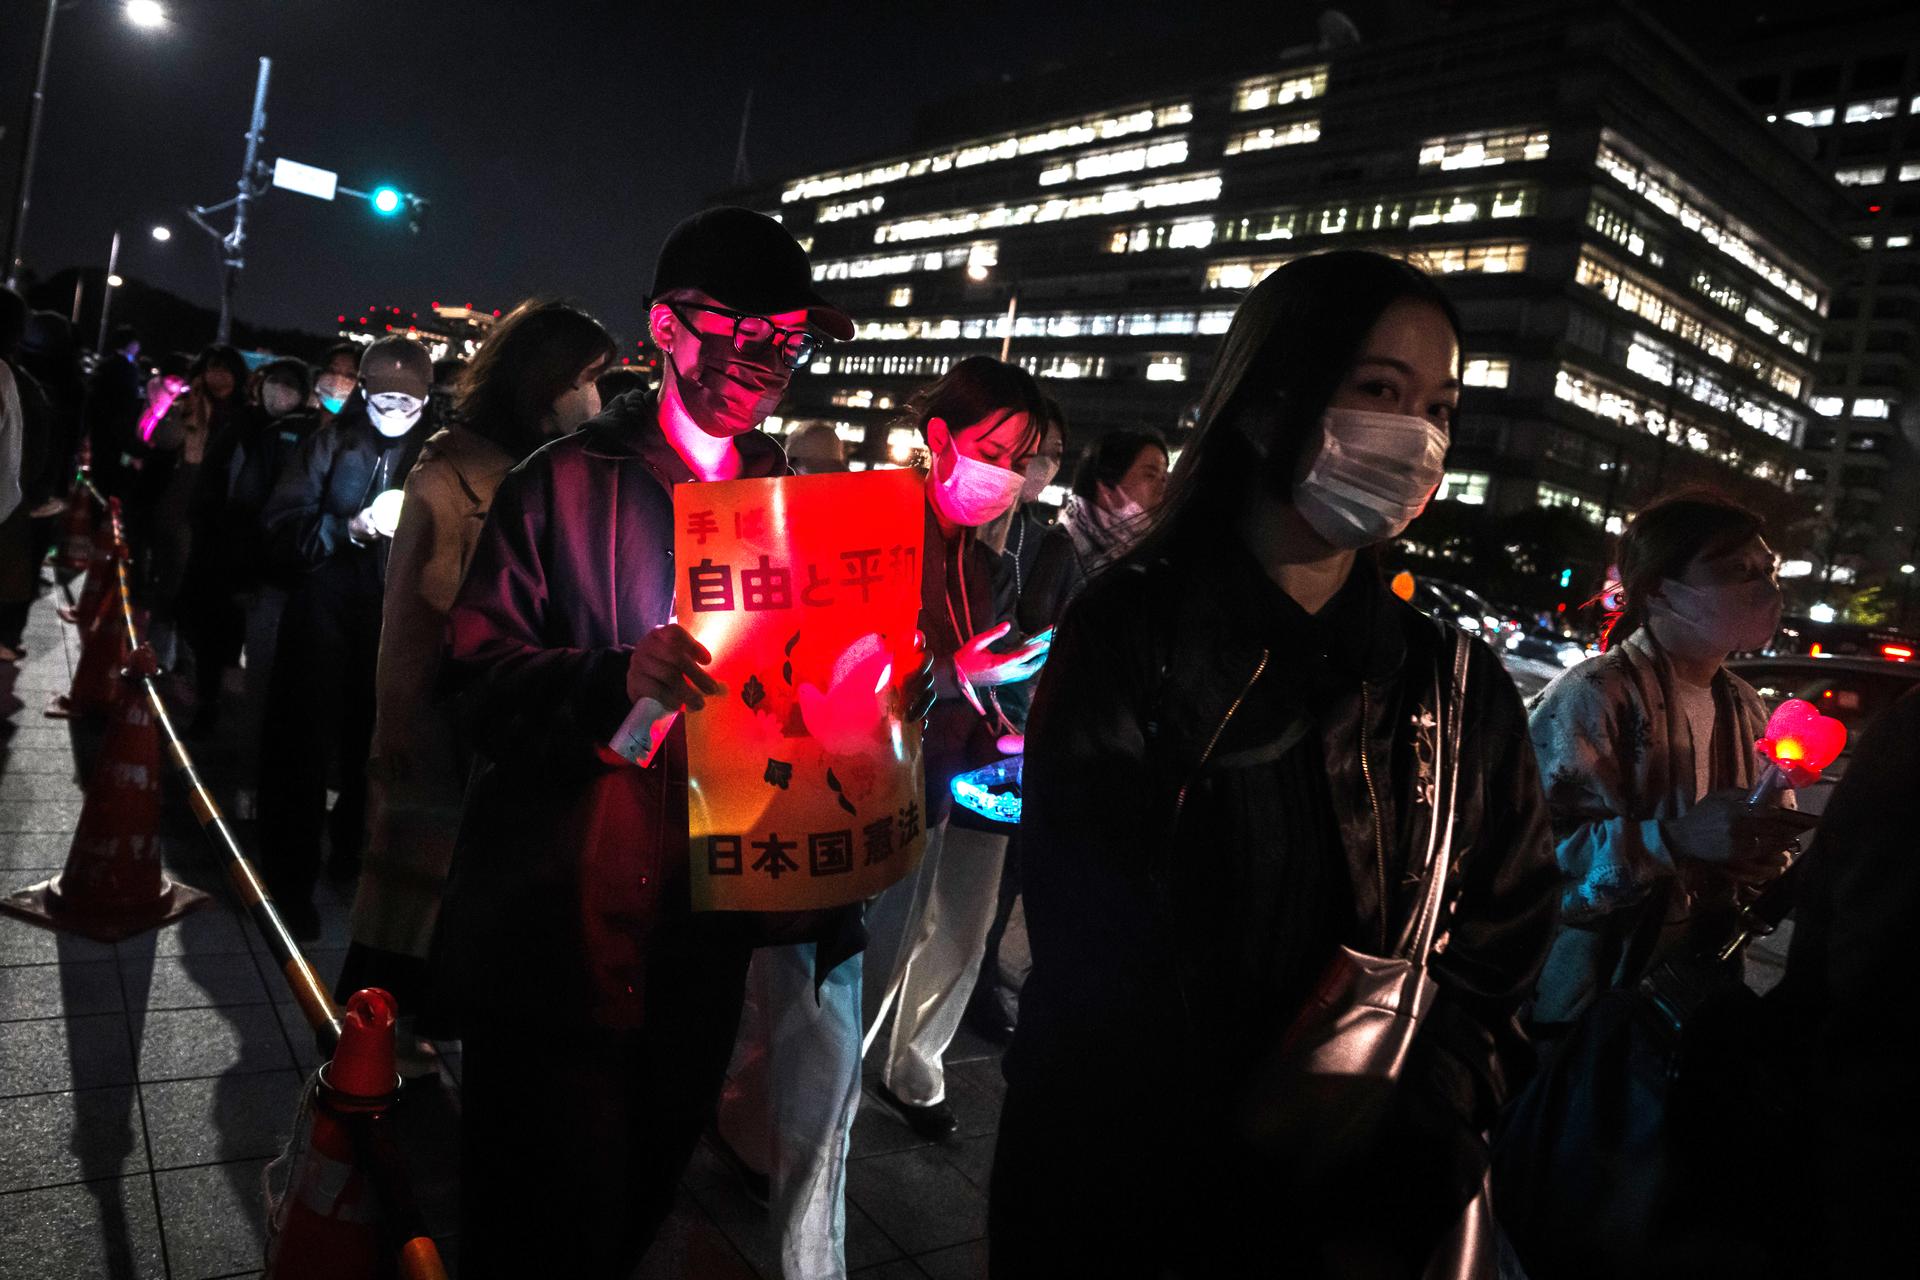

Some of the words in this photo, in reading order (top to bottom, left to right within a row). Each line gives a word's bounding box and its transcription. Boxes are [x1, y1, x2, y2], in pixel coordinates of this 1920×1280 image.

[707, 801, 920, 879] 日本国憲法
